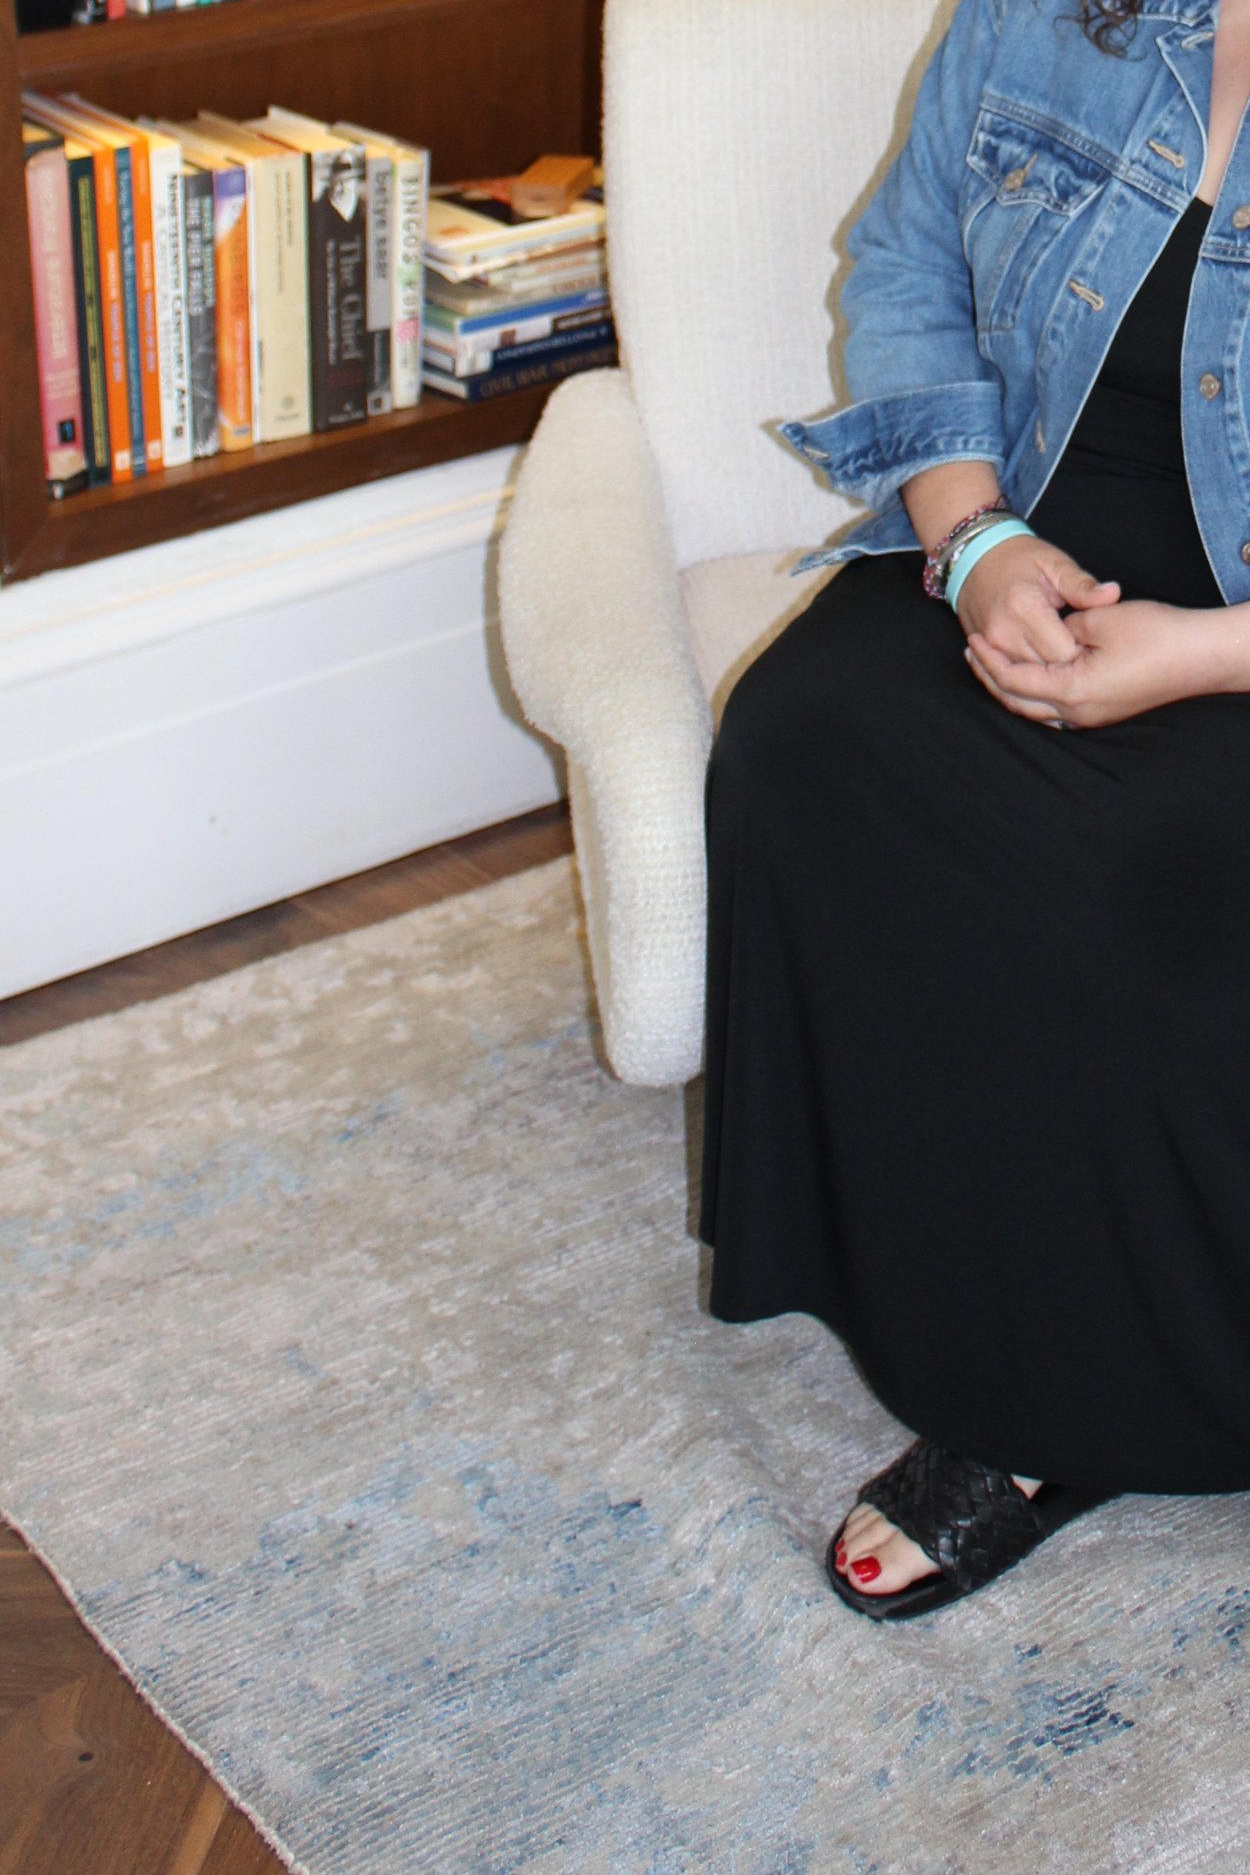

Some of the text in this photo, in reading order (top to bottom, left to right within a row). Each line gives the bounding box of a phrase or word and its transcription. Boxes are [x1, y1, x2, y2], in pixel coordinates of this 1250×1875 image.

[187, 197, 203, 317] THE PIER FALLS
[373, 172, 391, 282] betye saar
[166, 173, 188, 423] NINETEENTH CENTURY ART
[339, 236, 364, 362] The Chief
